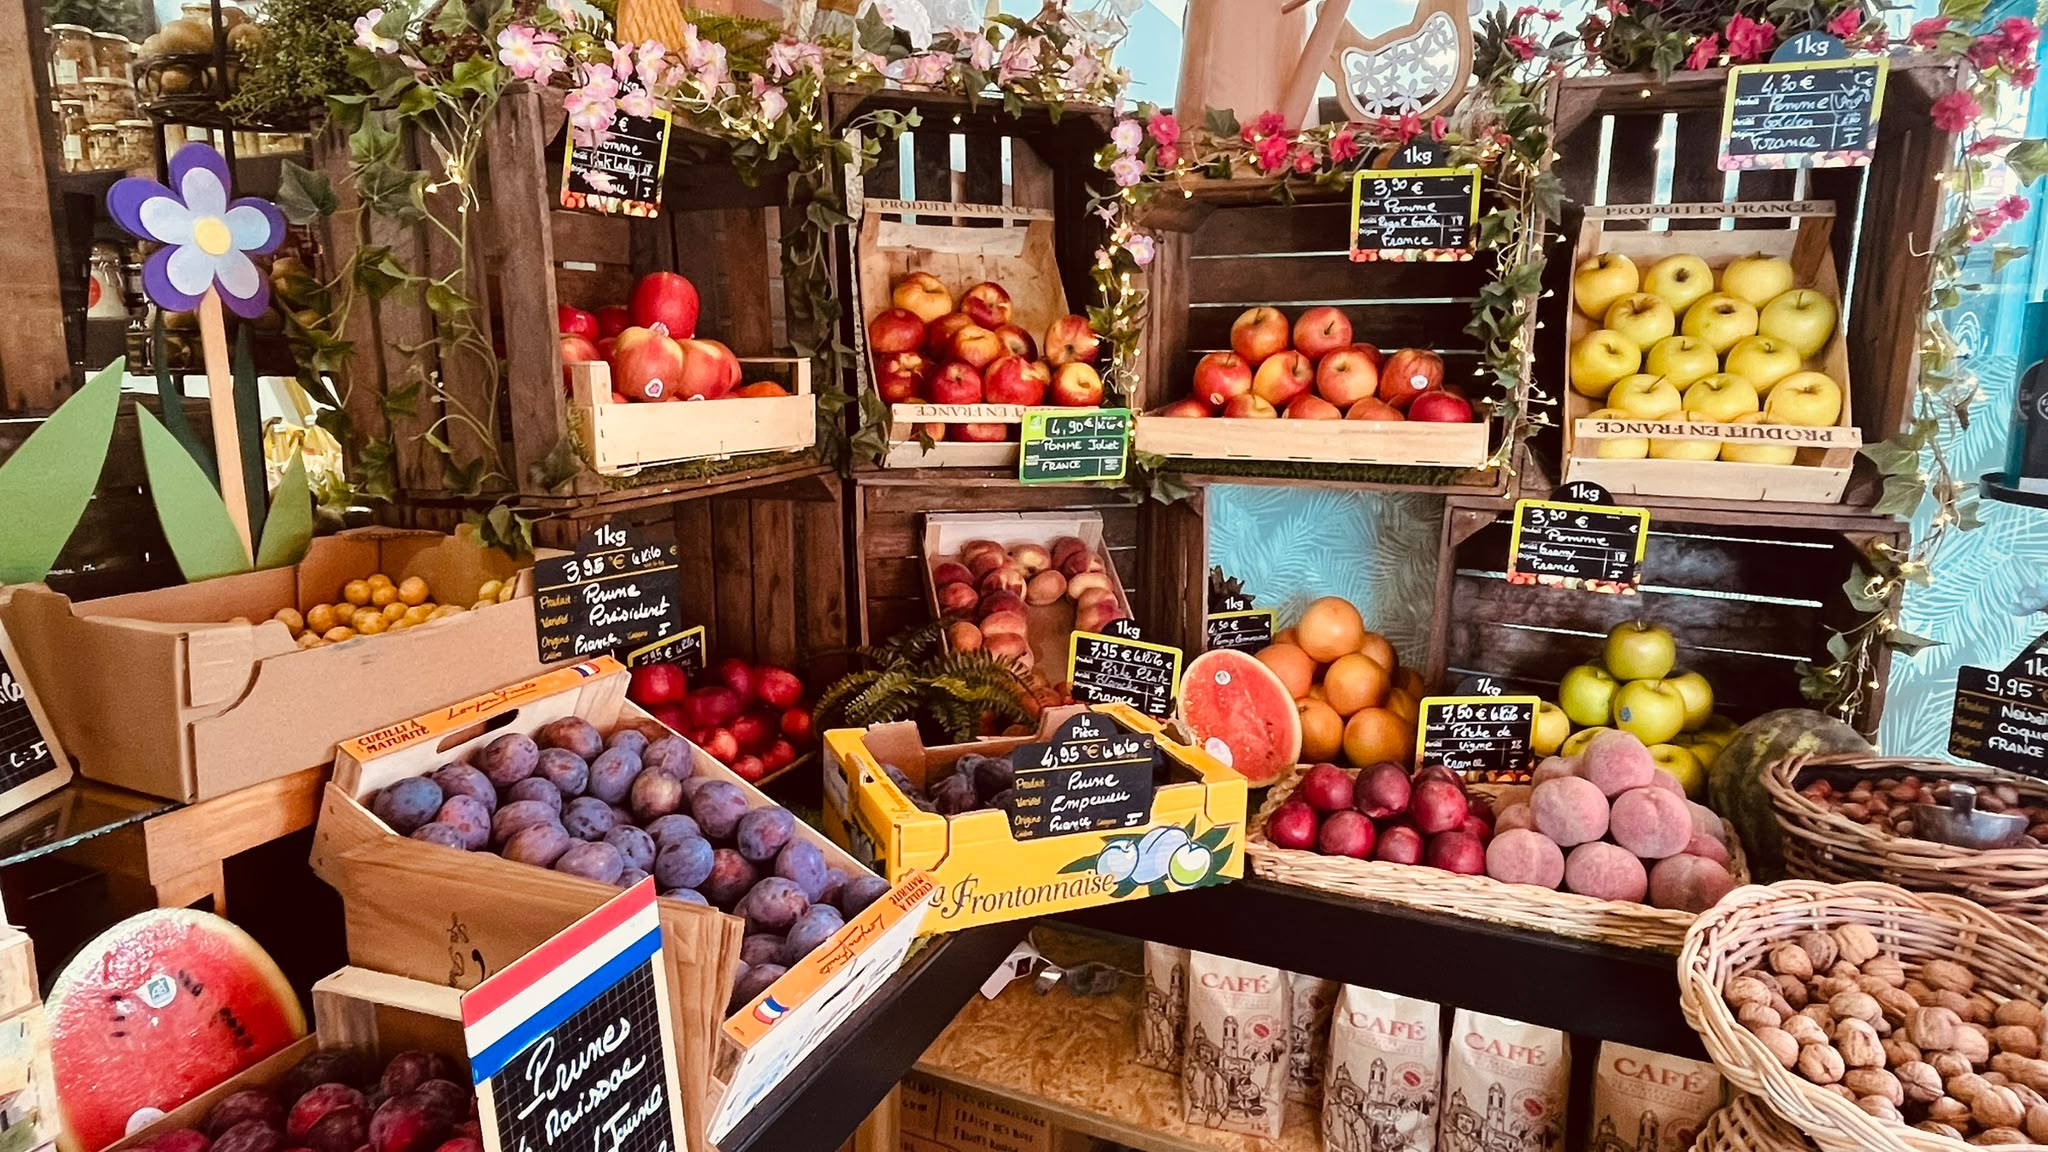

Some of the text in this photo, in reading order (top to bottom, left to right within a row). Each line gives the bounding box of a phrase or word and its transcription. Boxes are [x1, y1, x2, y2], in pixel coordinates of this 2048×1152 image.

[1795, 35, 1830, 57] 1kg
[1761, 74, 1797, 98] 4,30
[1800, 75, 1815, 90] €
[1769, 94, 1829, 113] Pomme
[619, 118, 629, 132] €
[600, 141, 642, 156] omme
[1750, 130, 1820, 150] France
[1403, 145, 1432, 165] 1kg
[1374, 178, 1408, 199] 3,90
[1411, 182, 1424, 195] €
[880, 200, 1034, 215] PRODUIT EN FRANCE
[1383, 199, 1437, 213] Pomme
[1606, 202, 1814, 216] PRODUIT EN FRANCE
[1381, 232, 1434, 247] France
[915, 405, 982, 418] FRANCE
[1596, 421, 1833, 443] PRODUIT EN FRANCE
[1041, 438, 1082, 451] POMME
[1041, 460, 1081, 472] FRANCE
[1570, 484, 1600, 502] 1kg
[1531, 509, 1567, 527] 3,90
[1575, 516, 1589, 528] €
[594, 525, 627, 546] 1kg
[1545, 528, 1609, 546] Pomme
[562, 557, 605, 585] 3,95
[611, 553, 625, 570] €
[1532, 558, 1579, 573] France
[583, 583, 641, 605] Prune
[1225, 596, 1244, 611] 1kg
[1116, 620, 1141, 640] 1kg
[1230, 620, 1239, 630] €
[575, 633, 618, 655] France
[1090, 641, 1118, 660] 7,95
[1121, 650, 1132, 662] €
[2025, 657, 2048, 678] 1k
[1477, 678, 1501, 696] 1kg
[1985, 674, 2034, 698] 9,95
[1087, 686, 1139, 707] France
[1475, 708, 1487, 720] €
[358, 725, 407, 746] CUEILLI
[1072, 726, 1100, 739] Pièce
[1041, 746, 1080, 768] 4,95
[1988, 736, 2045, 758] FRANCE
[941, 872, 1115, 919] Frontonnaise
[1201, 973, 1271, 995] CAFÉ
[1350, 1012, 1426, 1041] CAFÉ
[525, 1017, 631, 1101] Prunes
[1464, 1032, 1547, 1067] CAFÉ
[1614, 1057, 1705, 1095] CAFÉ
